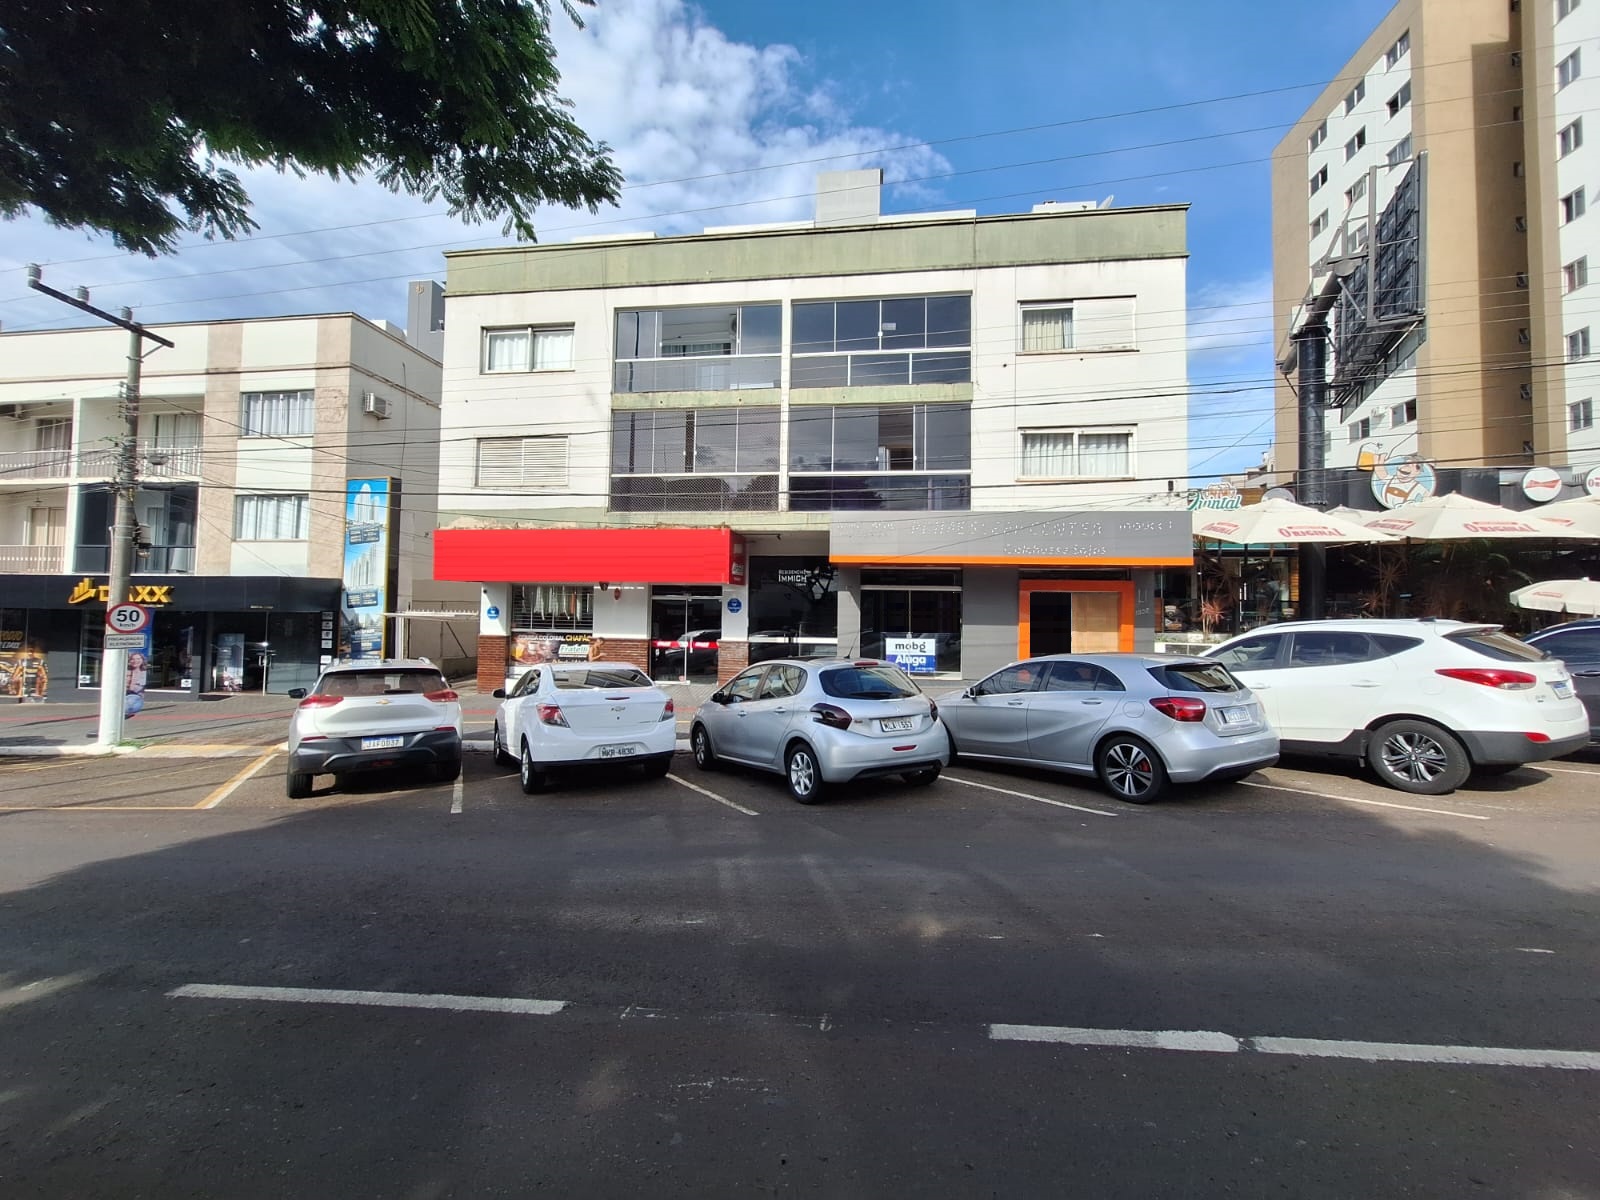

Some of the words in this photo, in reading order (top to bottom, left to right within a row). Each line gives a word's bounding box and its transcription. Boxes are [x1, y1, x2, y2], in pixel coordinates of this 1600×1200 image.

[1278, 527, 1346, 538] ORIGINAL
[778, 575, 807, 583] IMMICH
[116, 610, 140, 622] 50
[560, 644, 588, 652] Fratelli
[895, 655, 927, 667] Aluga
